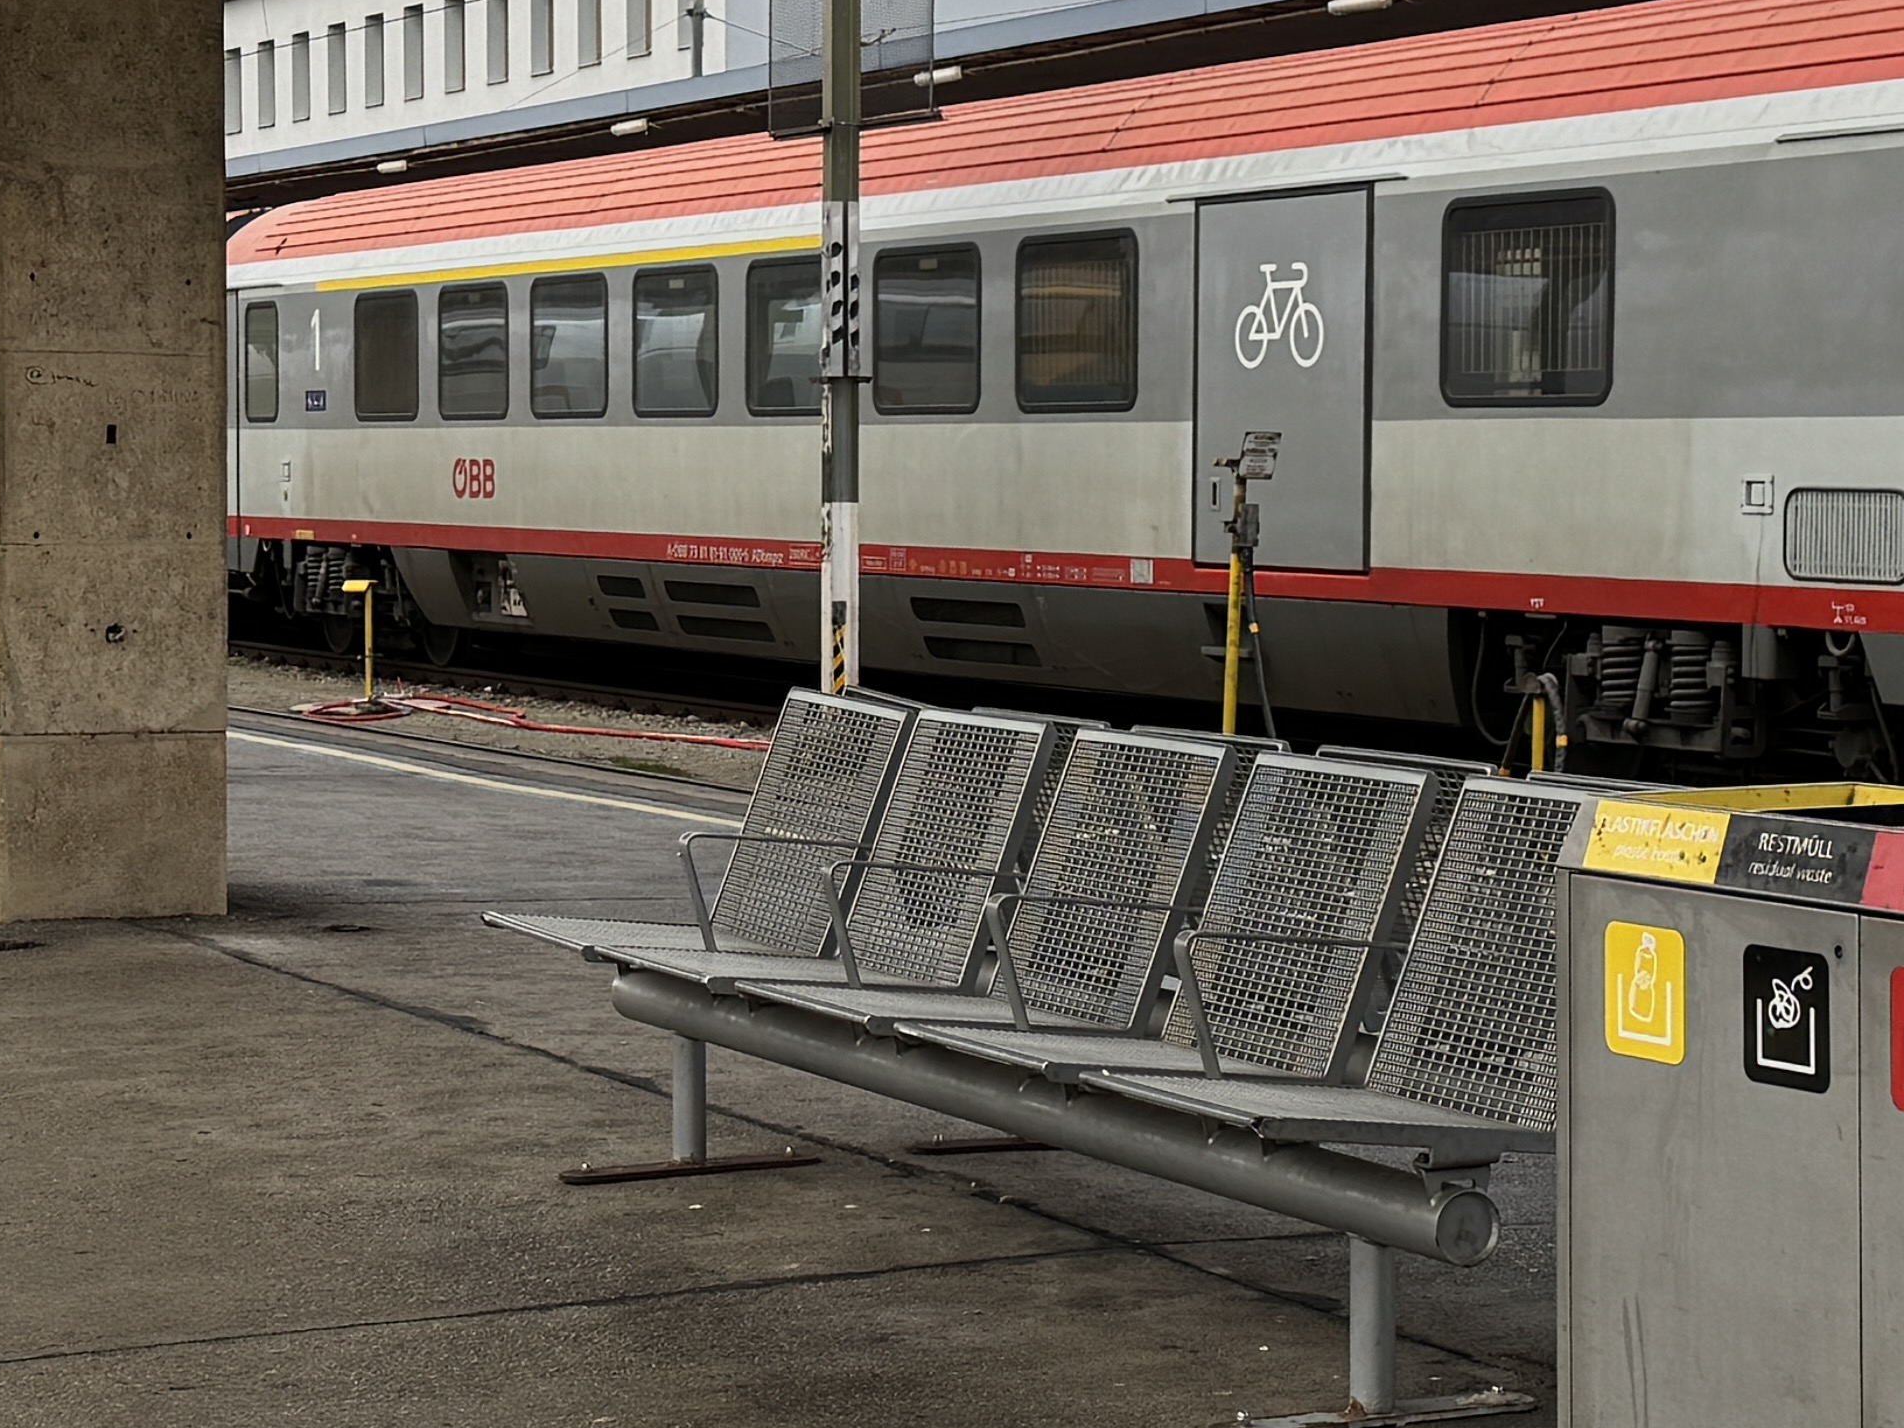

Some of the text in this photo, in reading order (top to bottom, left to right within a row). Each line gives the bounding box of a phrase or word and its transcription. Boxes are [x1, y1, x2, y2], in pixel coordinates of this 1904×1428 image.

[310, 308, 320, 371] 1
[452, 457, 496, 499] ÖBB
[1757, 832, 1833, 859] RESTMÜLL
[1748, 859, 1833, 884] residual waste
